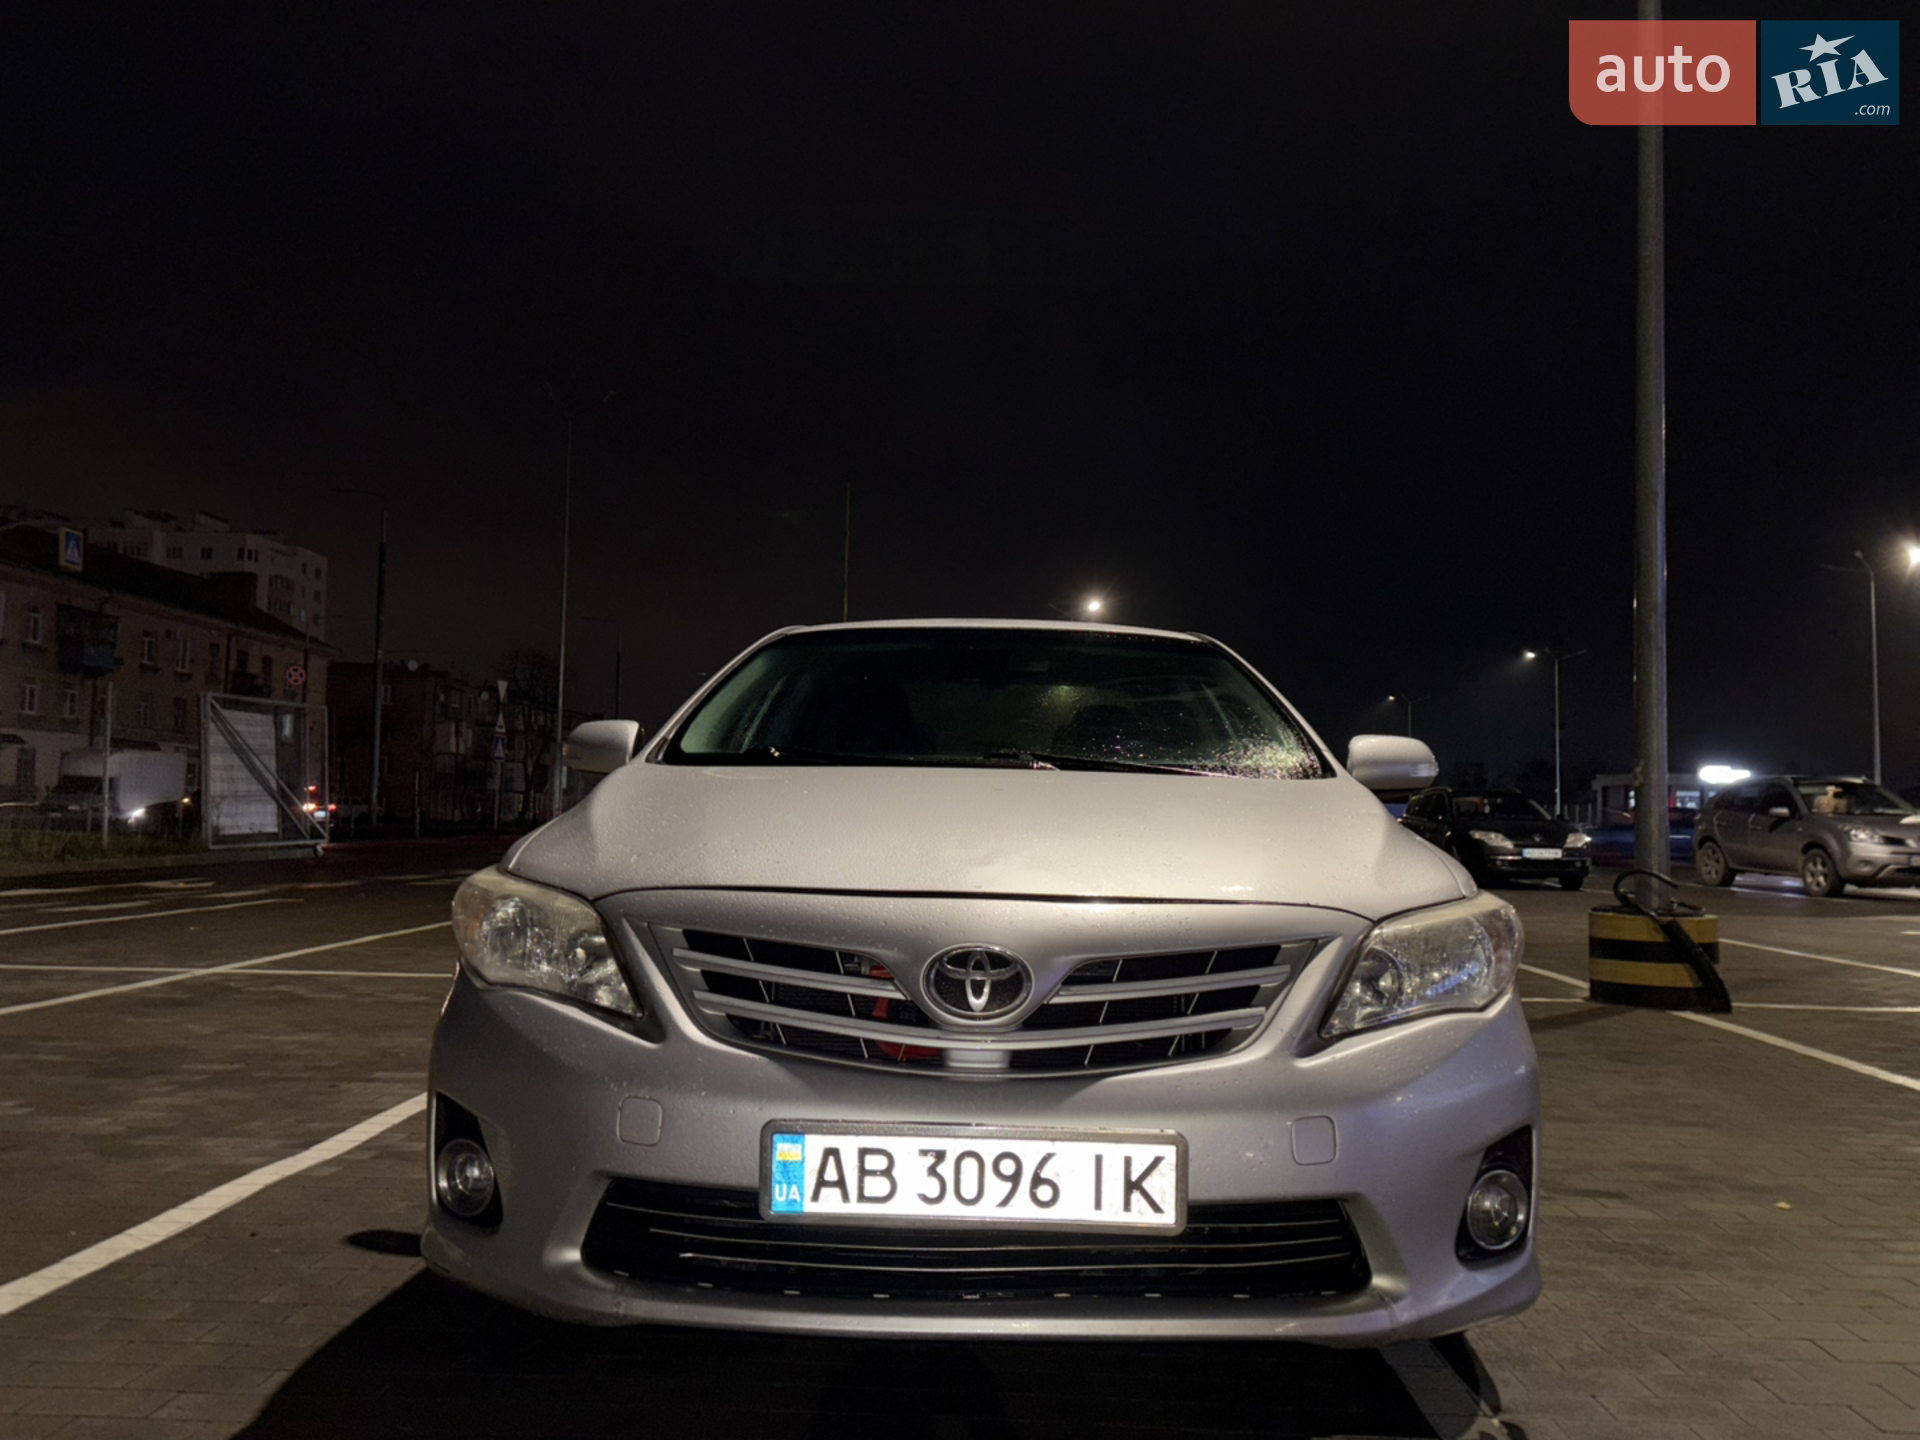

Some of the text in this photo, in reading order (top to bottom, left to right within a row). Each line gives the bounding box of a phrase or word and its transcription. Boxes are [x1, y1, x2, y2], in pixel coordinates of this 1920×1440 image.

[775, 1184, 801, 1203] UA
[810, 1147, 1166, 1214] AB 3096 IK
